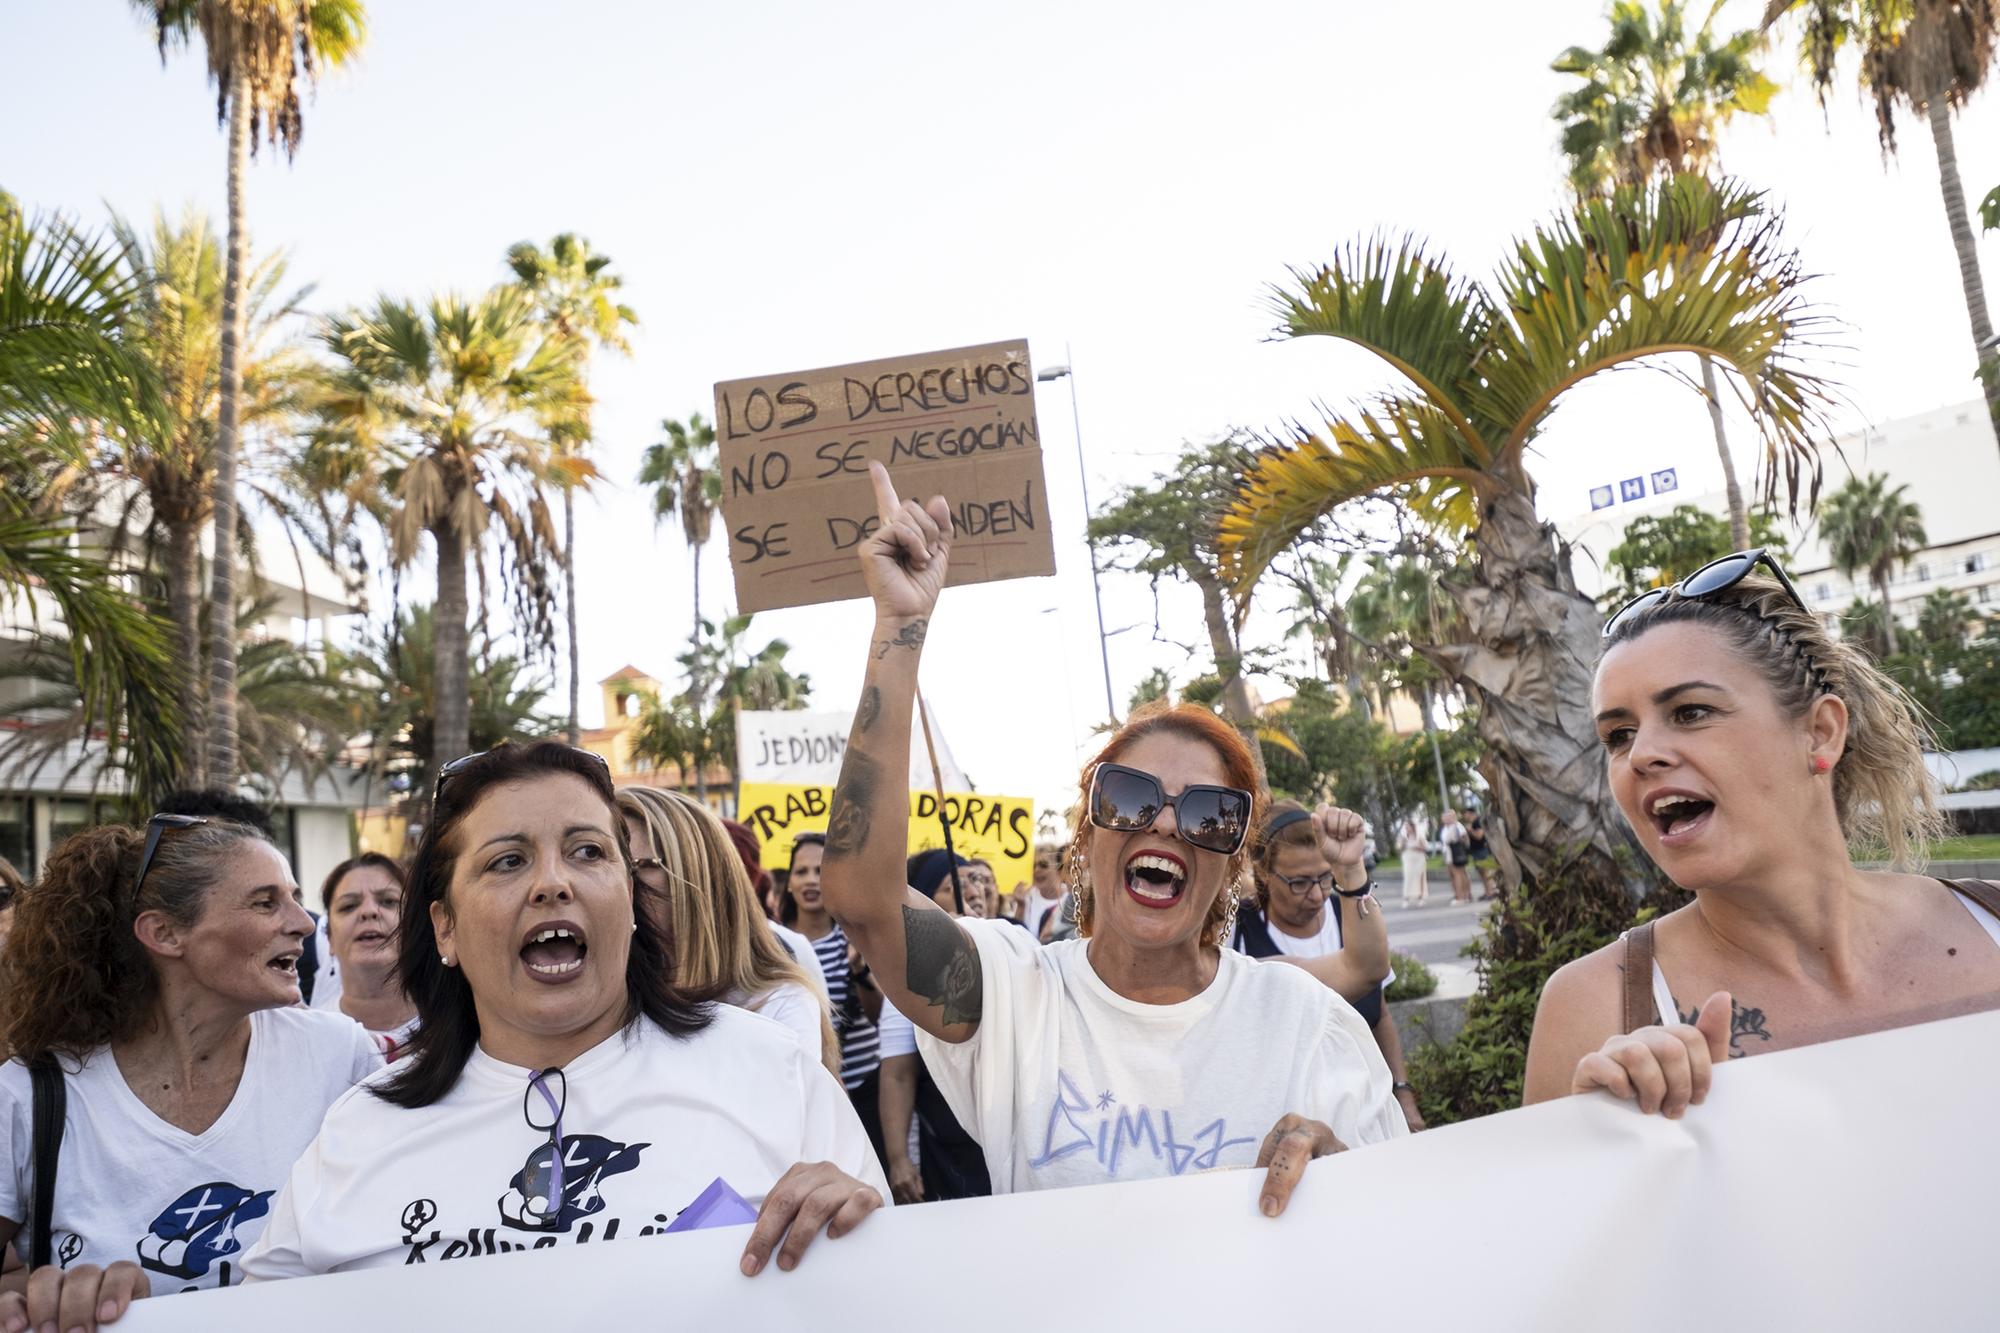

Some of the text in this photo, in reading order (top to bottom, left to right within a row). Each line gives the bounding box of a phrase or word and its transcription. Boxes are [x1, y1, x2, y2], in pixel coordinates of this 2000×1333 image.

[723, 361, 1031, 441] LOS DERECHOS
[731, 451, 790, 498] NO
[816, 440, 871, 479] SE
[735, 480, 1035, 564] SE DENDEN
